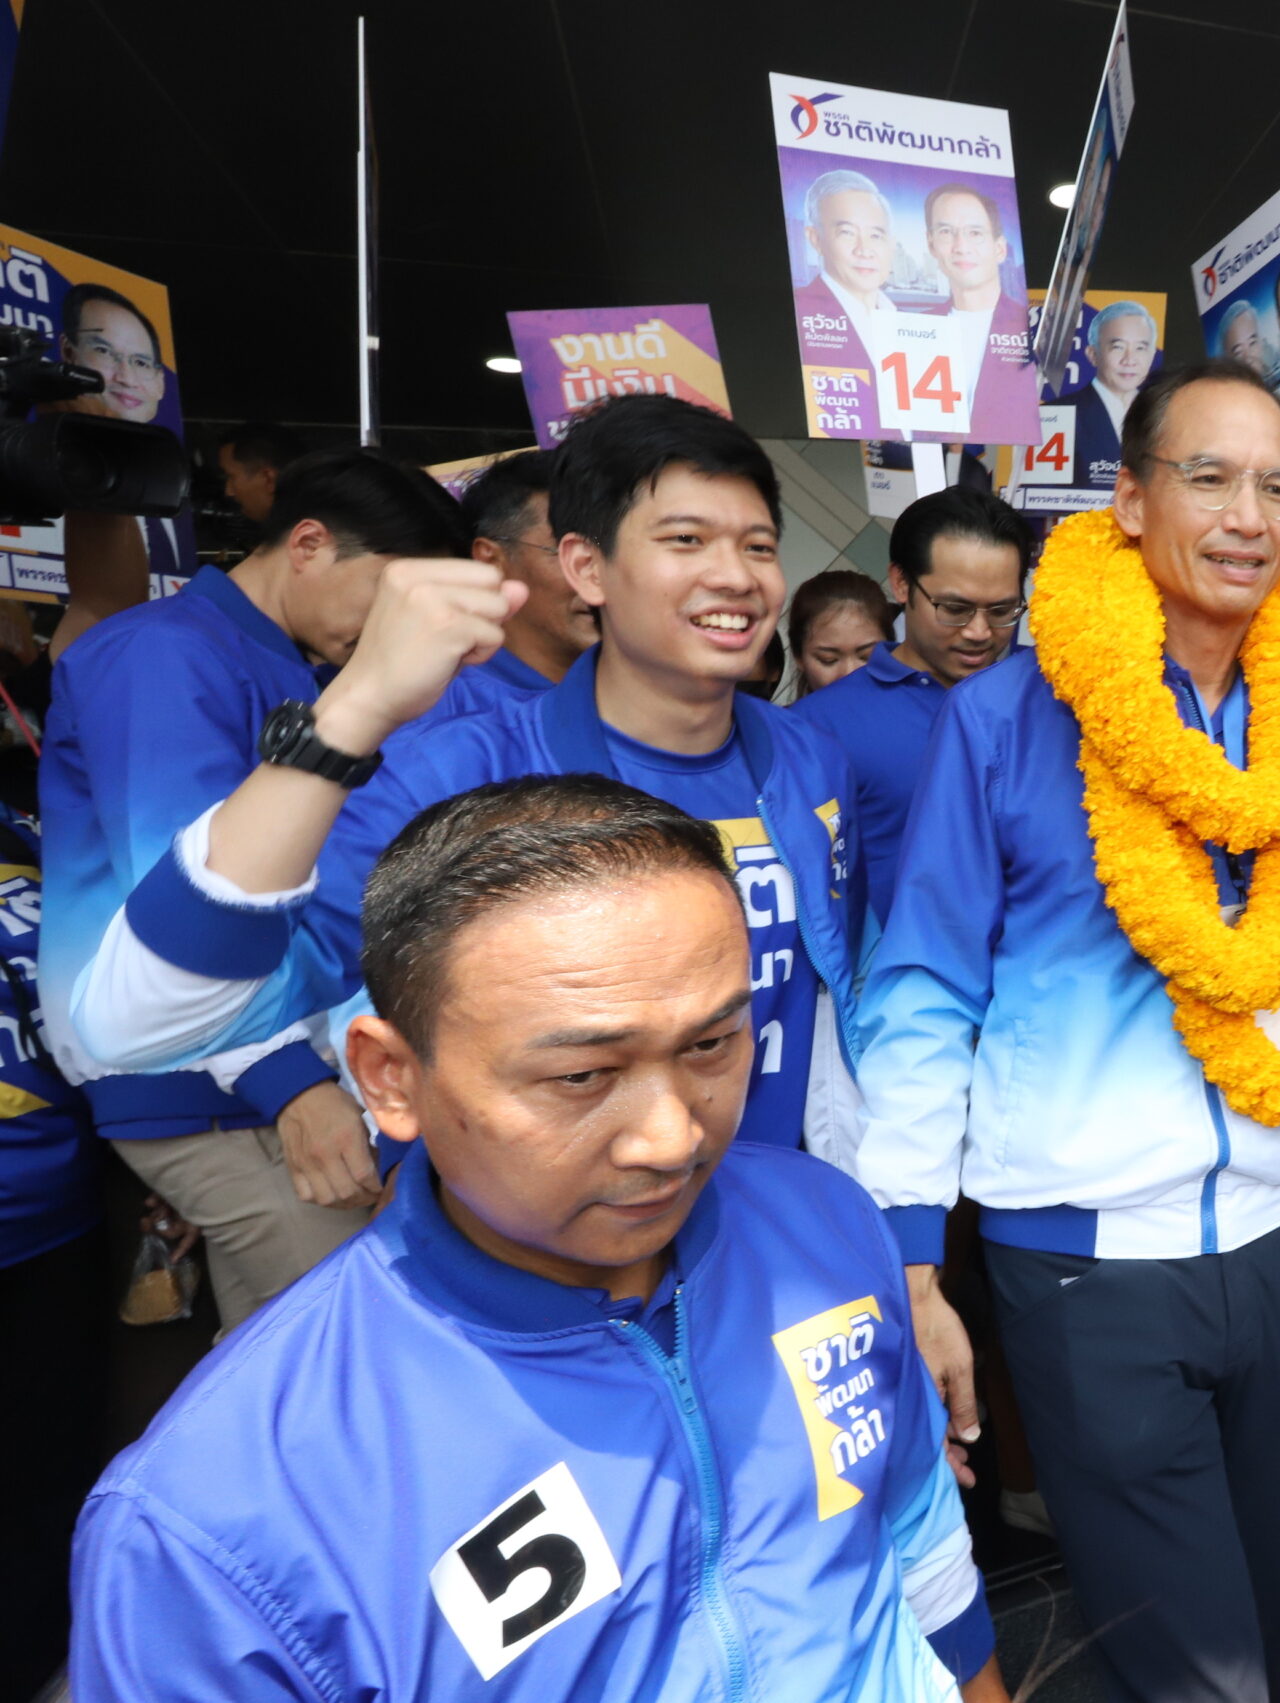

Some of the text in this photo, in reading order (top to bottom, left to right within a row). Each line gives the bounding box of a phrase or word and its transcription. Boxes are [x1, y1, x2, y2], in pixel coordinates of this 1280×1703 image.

[823, 119, 1002, 160] ชาติพัฒนากล้า
[0, 246, 50, 303] ติ
[555, 320, 667, 364] งานดี
[802, 313, 848, 333] สุวัจน์
[811, 372, 858, 393] ชาติ
[815, 391, 860, 407] พัฒนา
[881, 351, 962, 414] 14
[816, 406, 862, 430] กล้า
[1024, 432, 1070, 472] 14
[735, 845, 797, 928] ติ
[750, 948, 794, 992] นา
[758, 1019, 784, 1075] า
[799, 1311, 875, 1383] ชาติ
[814, 1367, 875, 1419] พัฒนา
[829, 1404, 887, 1476] กล้า
[456, 1488, 587, 1649] 5
